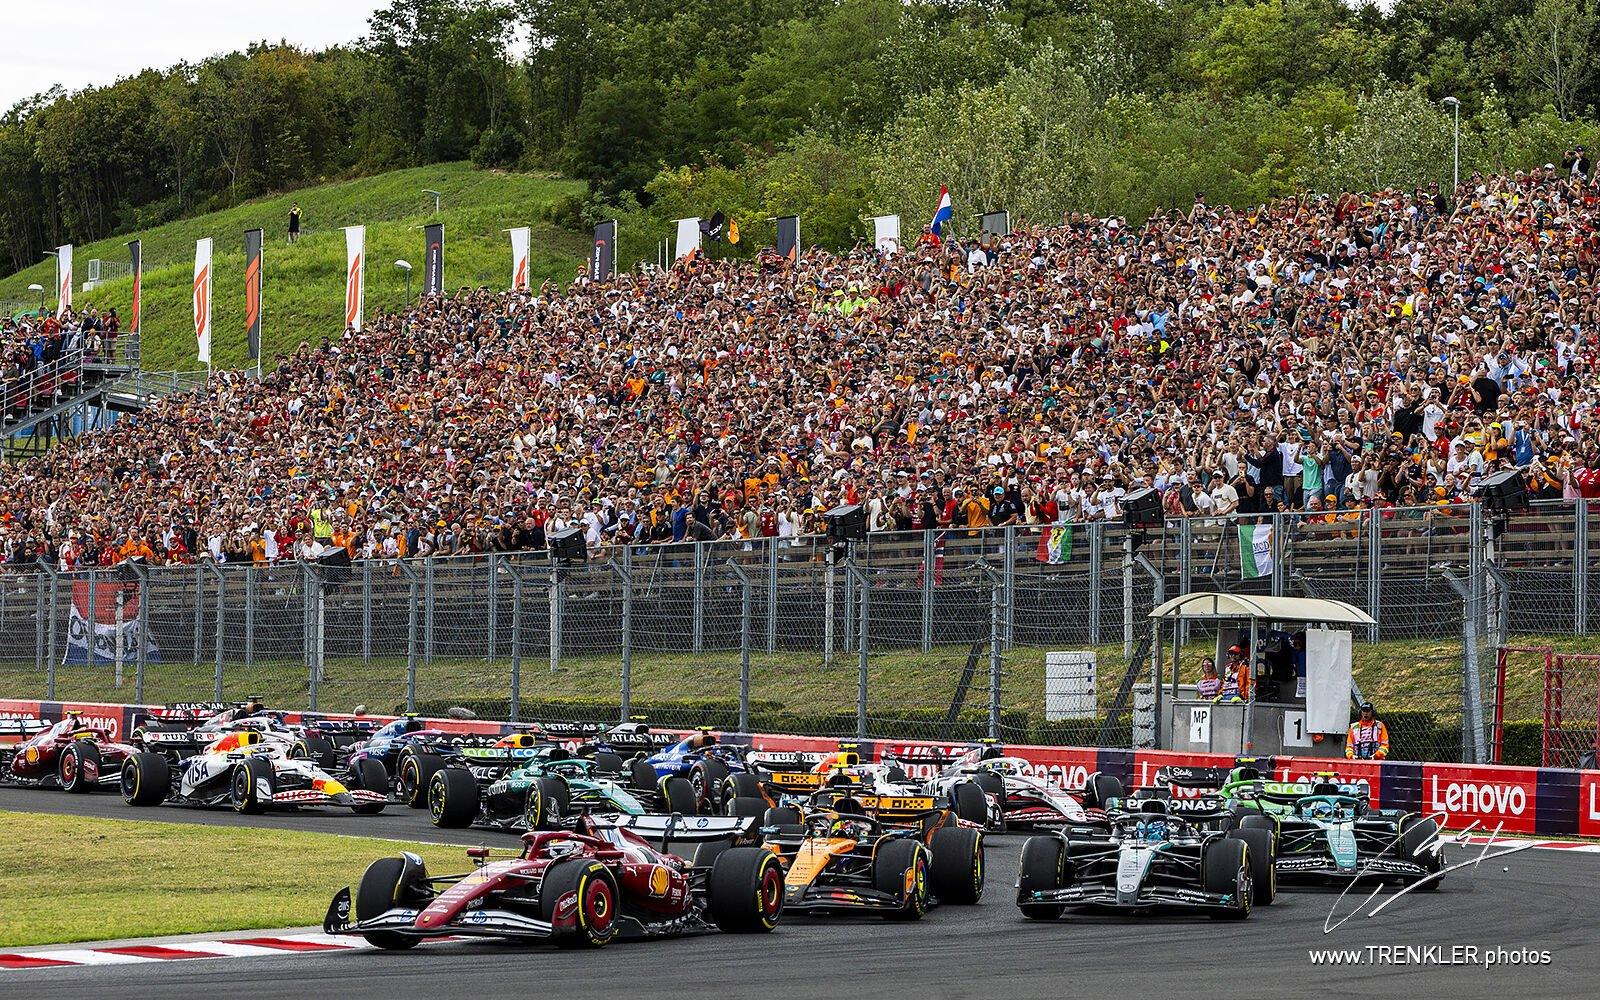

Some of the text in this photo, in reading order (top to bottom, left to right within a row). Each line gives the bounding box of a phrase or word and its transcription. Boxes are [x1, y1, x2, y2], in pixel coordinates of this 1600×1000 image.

[1193, 710, 1208, 723] MP
[67, 715, 118, 738] novo
[1197, 726, 1202, 739] 1
[1293, 718, 1302, 740] 1
[187, 761, 210, 786] VISA
[465, 766, 499, 780] ACLE
[1021, 764, 1089, 790] enovo
[1173, 767, 1193, 777] Stake
[781, 775, 810, 784] OKX
[1431, 774, 1526, 816] Lenovo
[892, 800, 925, 809] OKX
[1126, 800, 1217, 811] PONAS
[338, 901, 350, 911] aws
